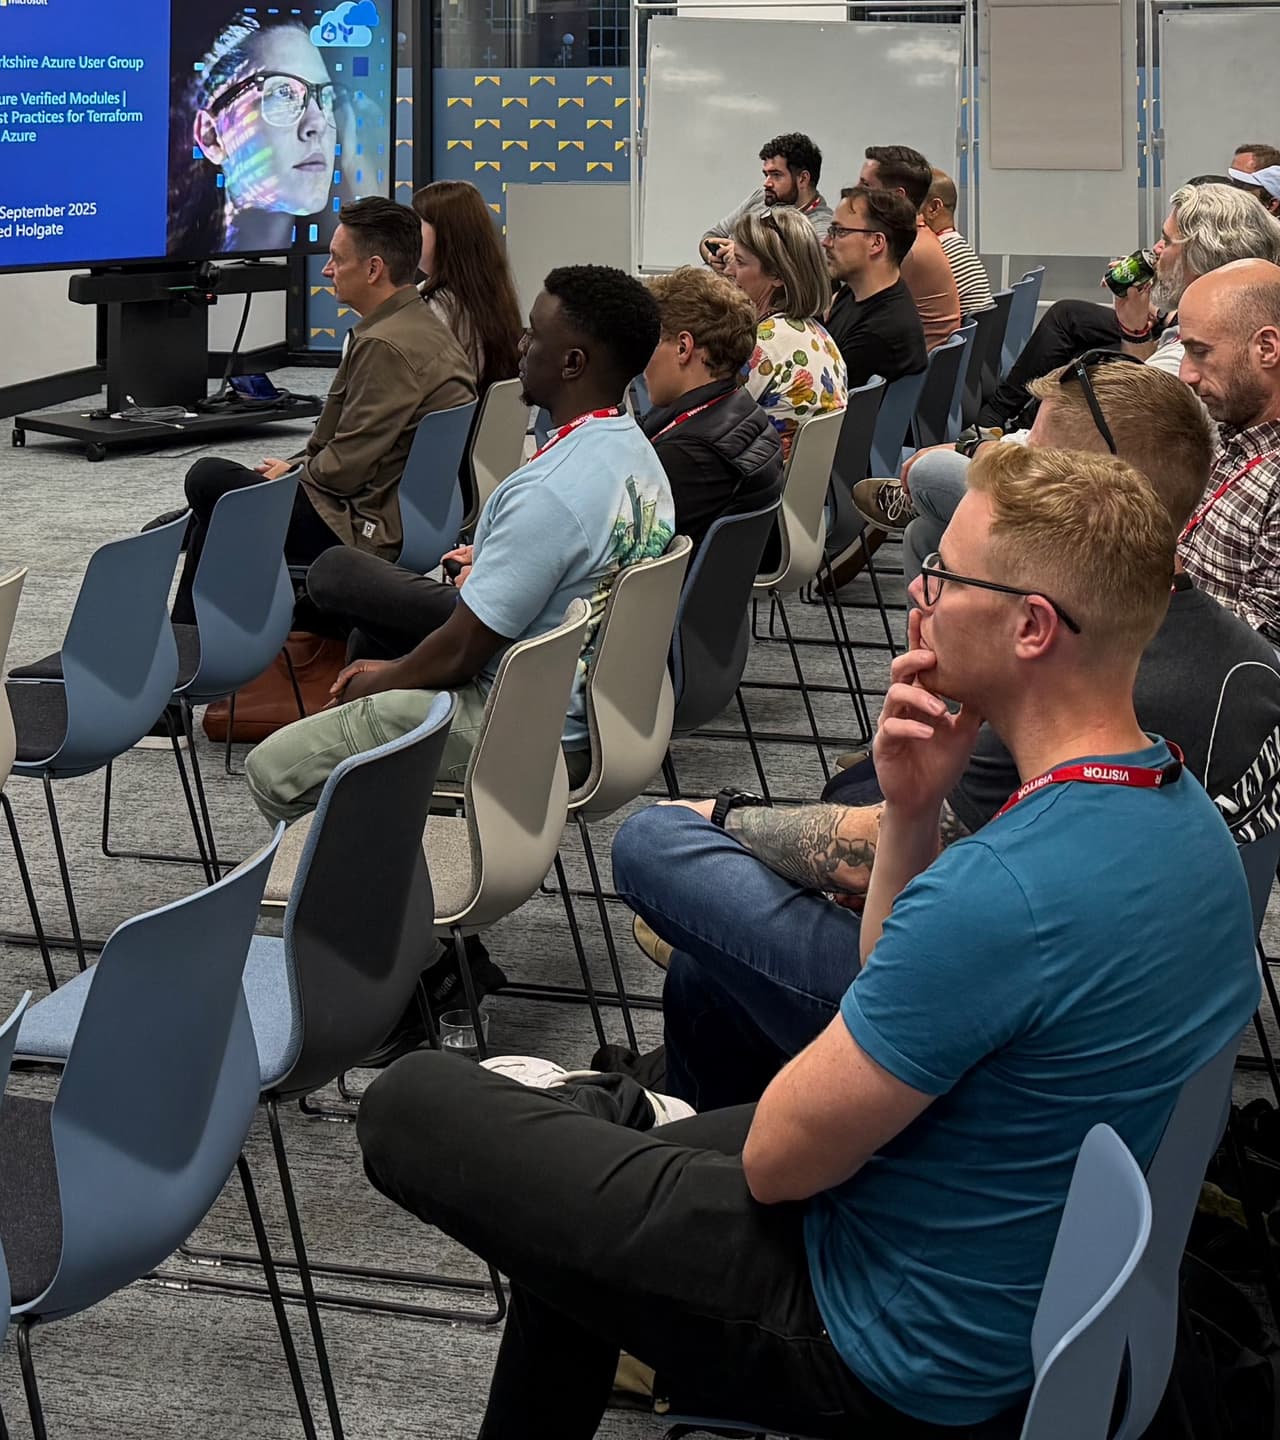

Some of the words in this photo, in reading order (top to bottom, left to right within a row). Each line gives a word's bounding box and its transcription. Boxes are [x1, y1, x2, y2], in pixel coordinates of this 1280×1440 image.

[41, 55, 76, 69] Azure
[78, 56, 105, 69] User
[107, 55, 144, 72] Group
[20, 91, 66, 105] Verified
[70, 90, 120, 105] Modules
[11, 109, 64, 123] Practices
[67, 109, 84, 123] for
[86, 108, 143, 122] Terraform
[1, 129, 37, 142] Azure
[67, 202, 97, 216] 2025
[15, 222, 64, 240] Holgate
[1083, 766, 1130, 782] VISITOR
[1018, 773, 1053, 799] VISITOR
